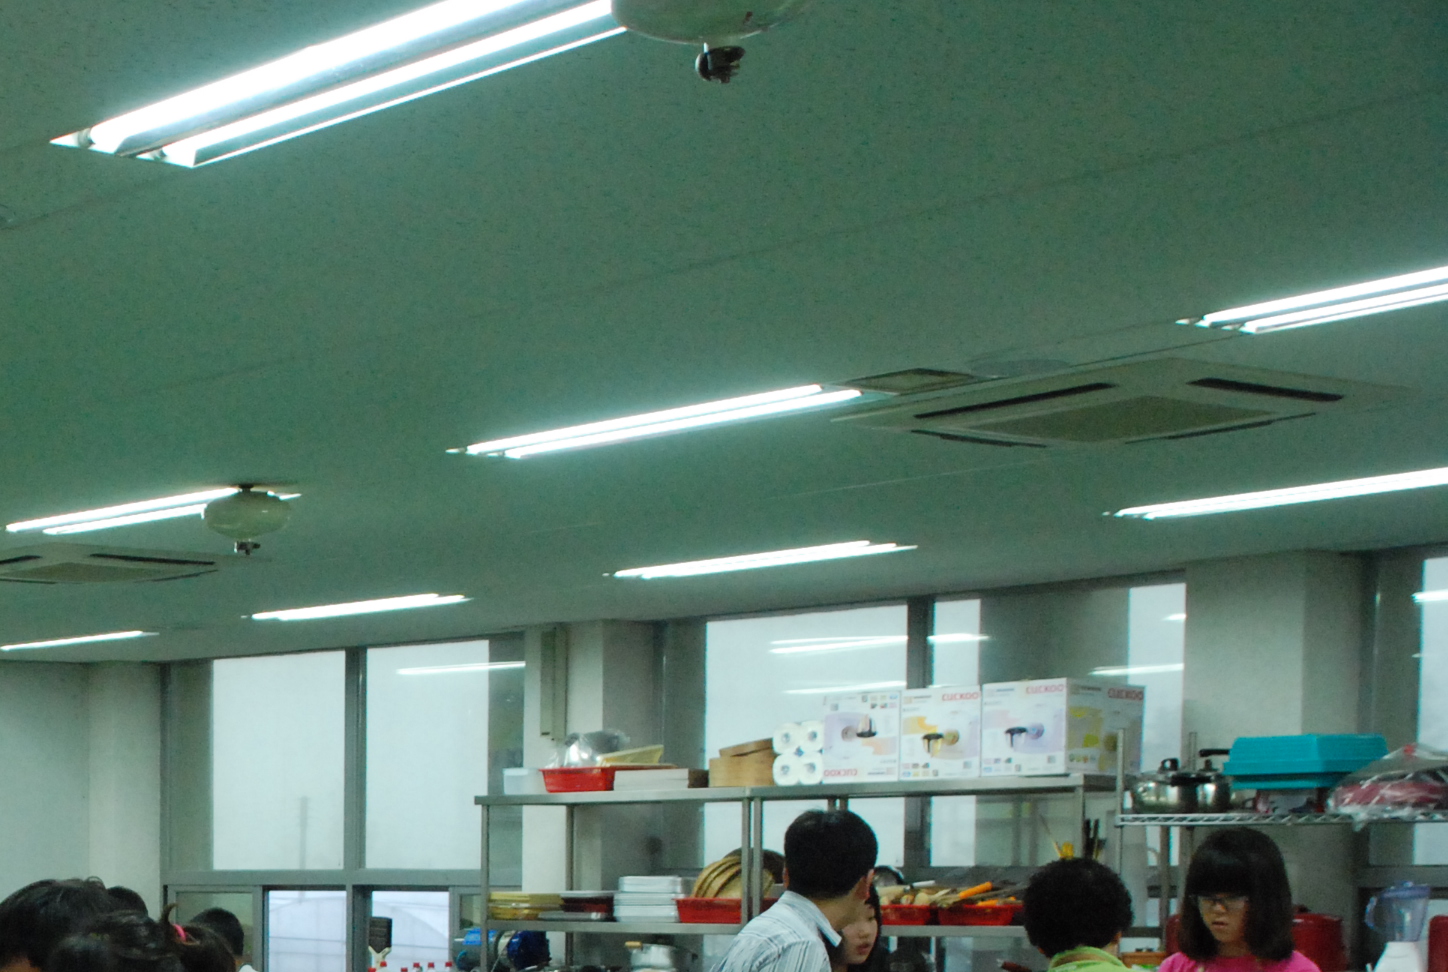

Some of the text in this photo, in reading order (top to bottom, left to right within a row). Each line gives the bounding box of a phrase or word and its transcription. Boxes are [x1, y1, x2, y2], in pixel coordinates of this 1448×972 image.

[1026, 683, 1065, 695] CUCKOO
[1108, 687, 1145, 701] CUCKOO
[941, 691, 981, 702] CUCKOO
